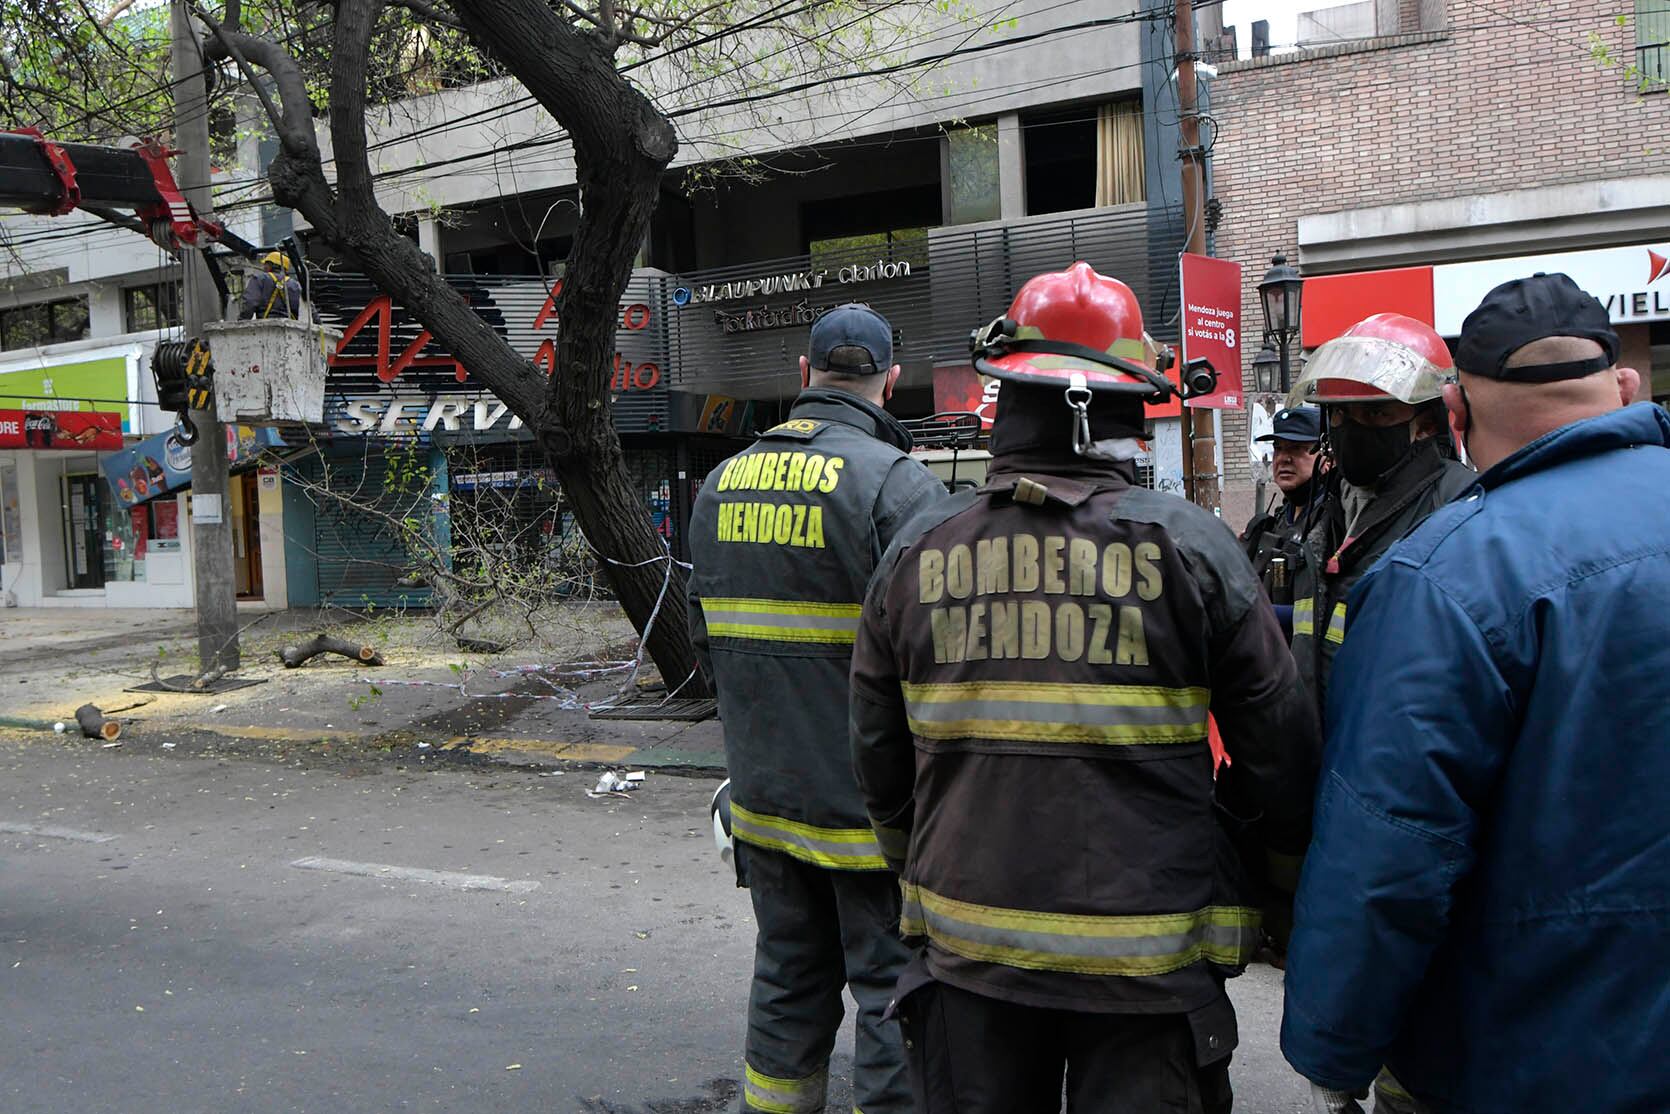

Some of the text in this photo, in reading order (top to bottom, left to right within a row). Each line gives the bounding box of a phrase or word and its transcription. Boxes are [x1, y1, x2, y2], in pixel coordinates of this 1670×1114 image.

[534, 279, 650, 330] Ao
[690, 270, 828, 304] BLAUPUNKT
[1188, 304, 1234, 319] Mendoza juega
[1197, 318, 1225, 329] al centro
[1188, 327, 1194, 336] si
[1195, 328, 1213, 339] votás
[1219, 331, 1225, 341] la
[1225, 328, 1235, 348] 8
[337, 395, 524, 432] SERV
[717, 452, 844, 493] BOMBEROS
[717, 502, 825, 548] MENDOZA
[919, 533, 1163, 603] BOMBEROS
[931, 600, 1149, 666] MENDOZA
